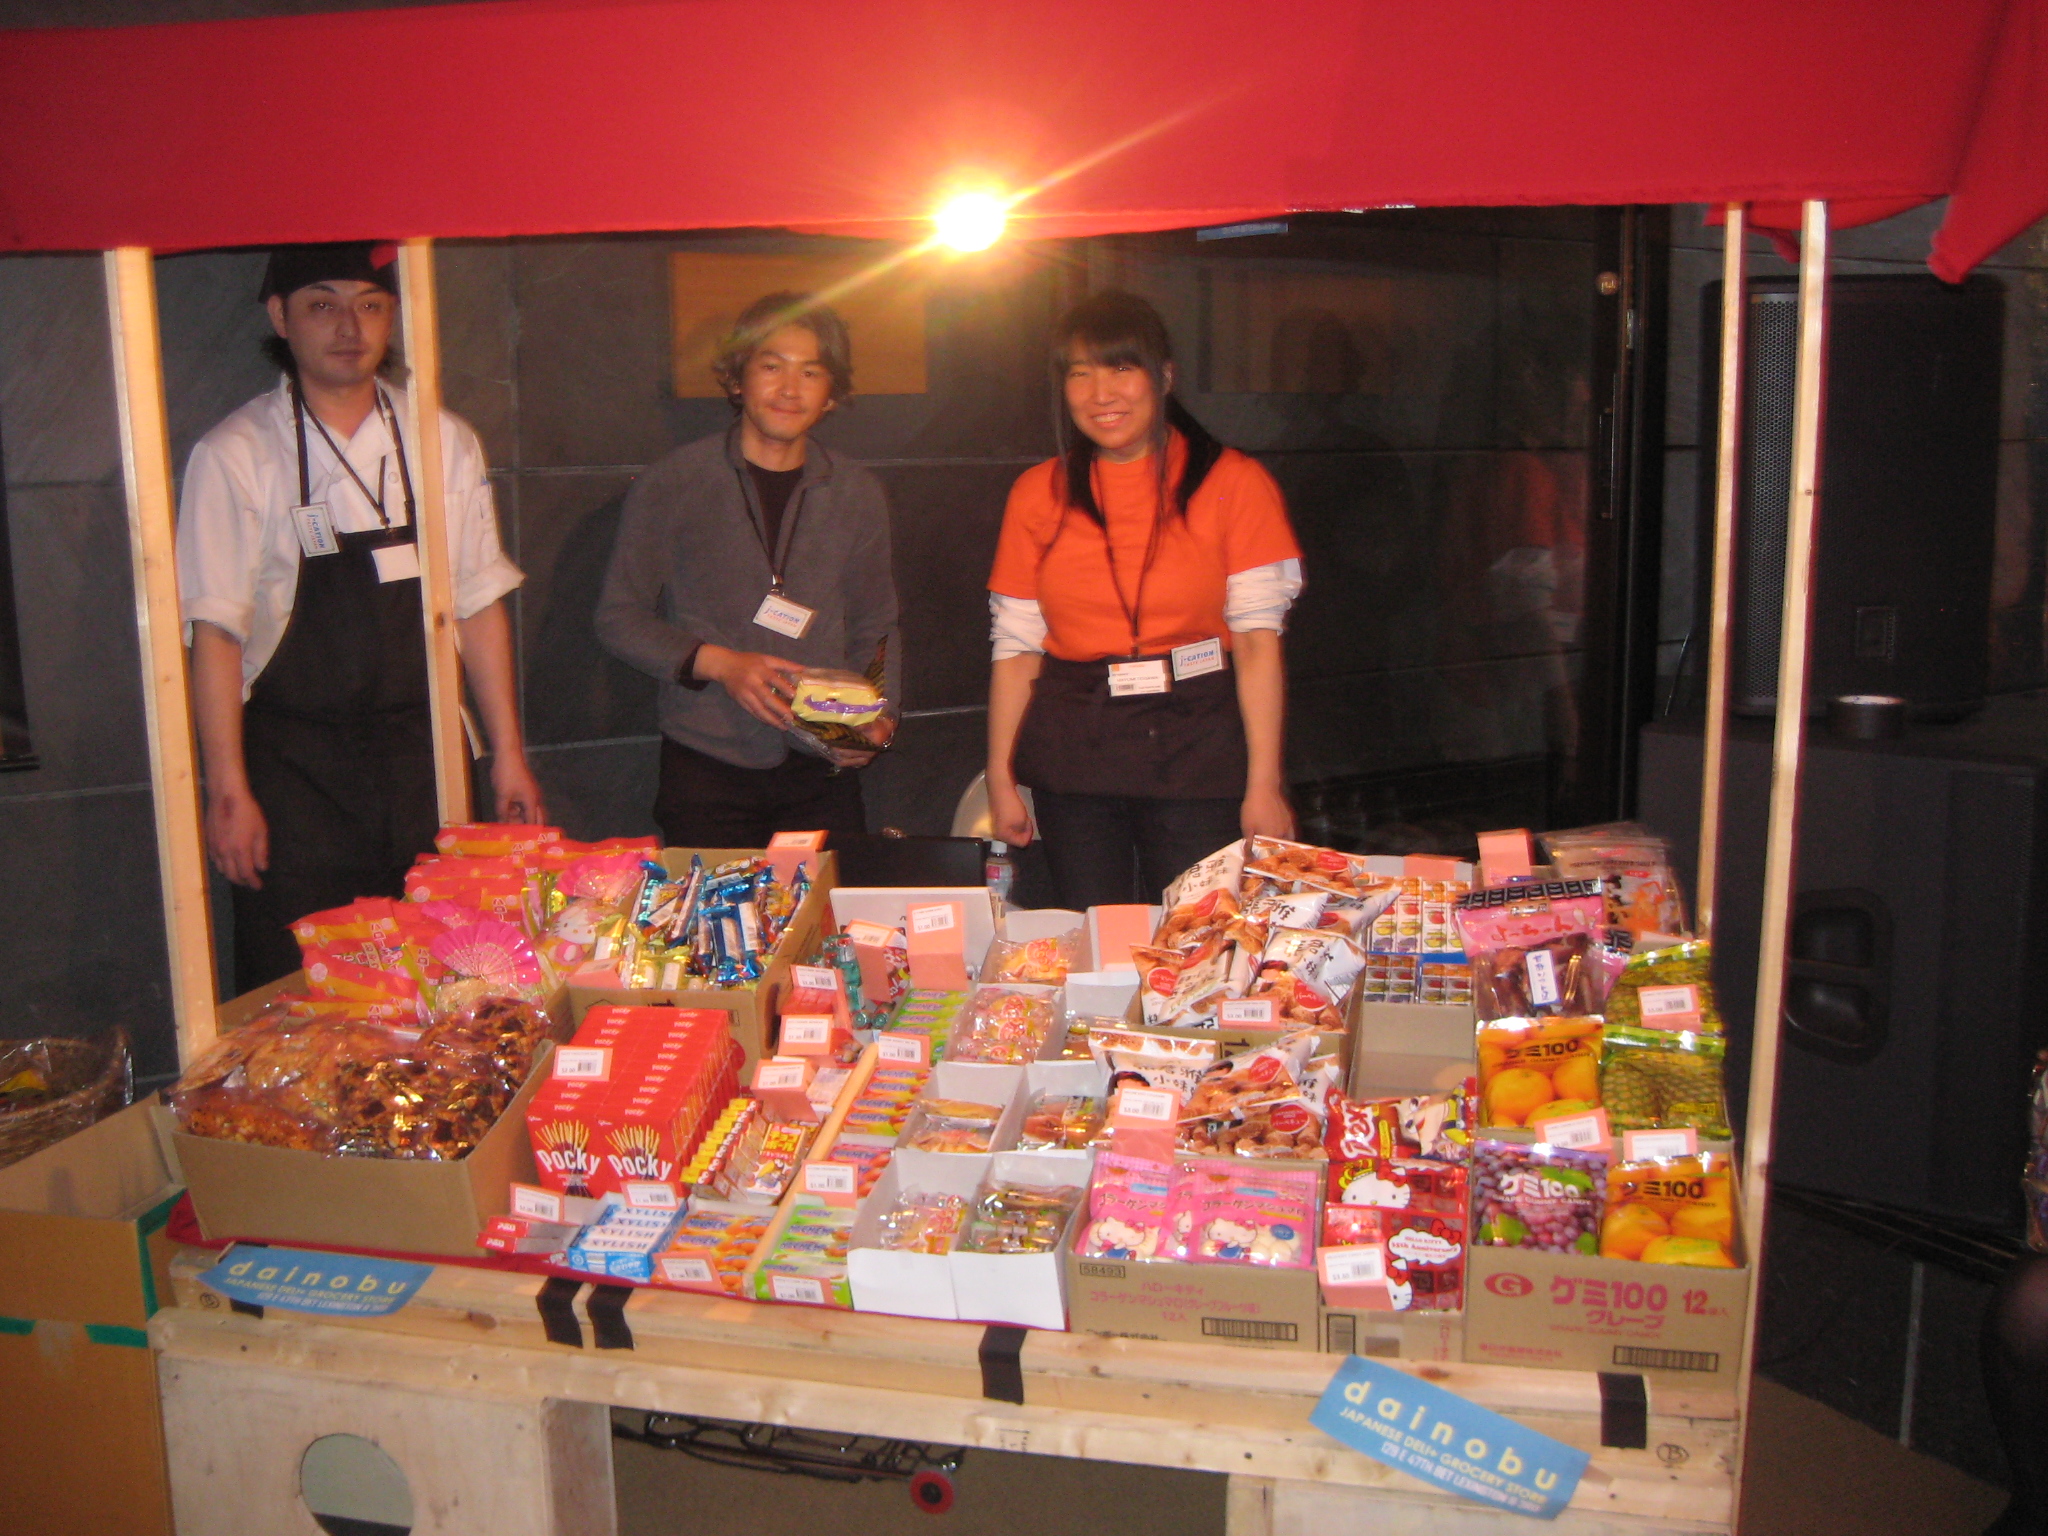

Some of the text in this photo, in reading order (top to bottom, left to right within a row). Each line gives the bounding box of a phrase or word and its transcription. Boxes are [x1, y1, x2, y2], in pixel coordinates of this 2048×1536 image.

[536, 1149, 601, 1176] Pocky
[607, 1153, 673, 1182] Pocky
[228, 1260, 407, 1295] dainobu
[1550, 1275, 1668, 1312] グミ100
[1585, 1310, 1666, 1329] グレープ
[1339, 1407, 1404, 1442] JAPANESE
[1440, 1453, 1507, 1487] GROCERY
[1343, 1381, 1558, 1490] dainobu
